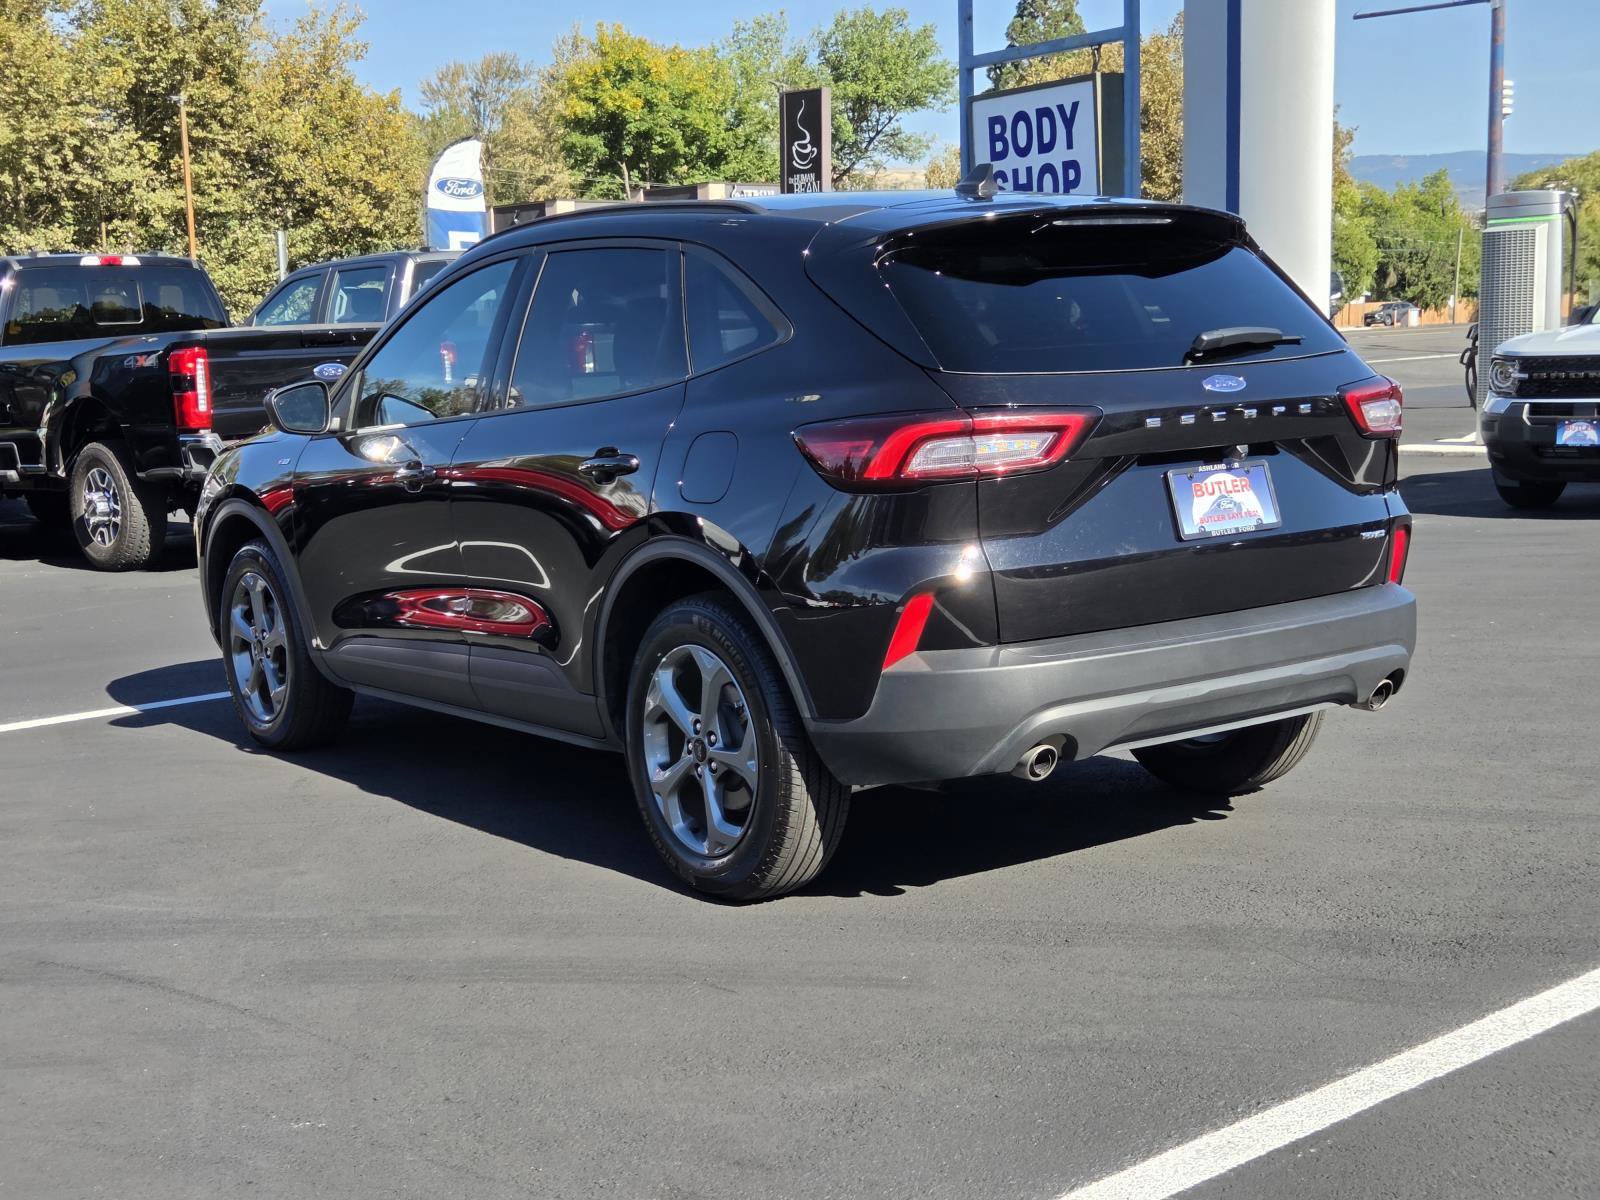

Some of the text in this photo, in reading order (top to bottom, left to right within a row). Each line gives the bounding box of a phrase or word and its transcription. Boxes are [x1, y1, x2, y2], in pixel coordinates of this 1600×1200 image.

[988, 101, 1080, 162] BODY
[794, 173, 816, 183] HUMAN
[444, 180, 477, 196] Ford
[1198, 463, 1226, 472] ASHLAND
[1192, 477, 1251, 497] BUTLER
[1199, 514, 1227, 525] BUTLER
[1211, 528, 1236, 537] BUTLER
